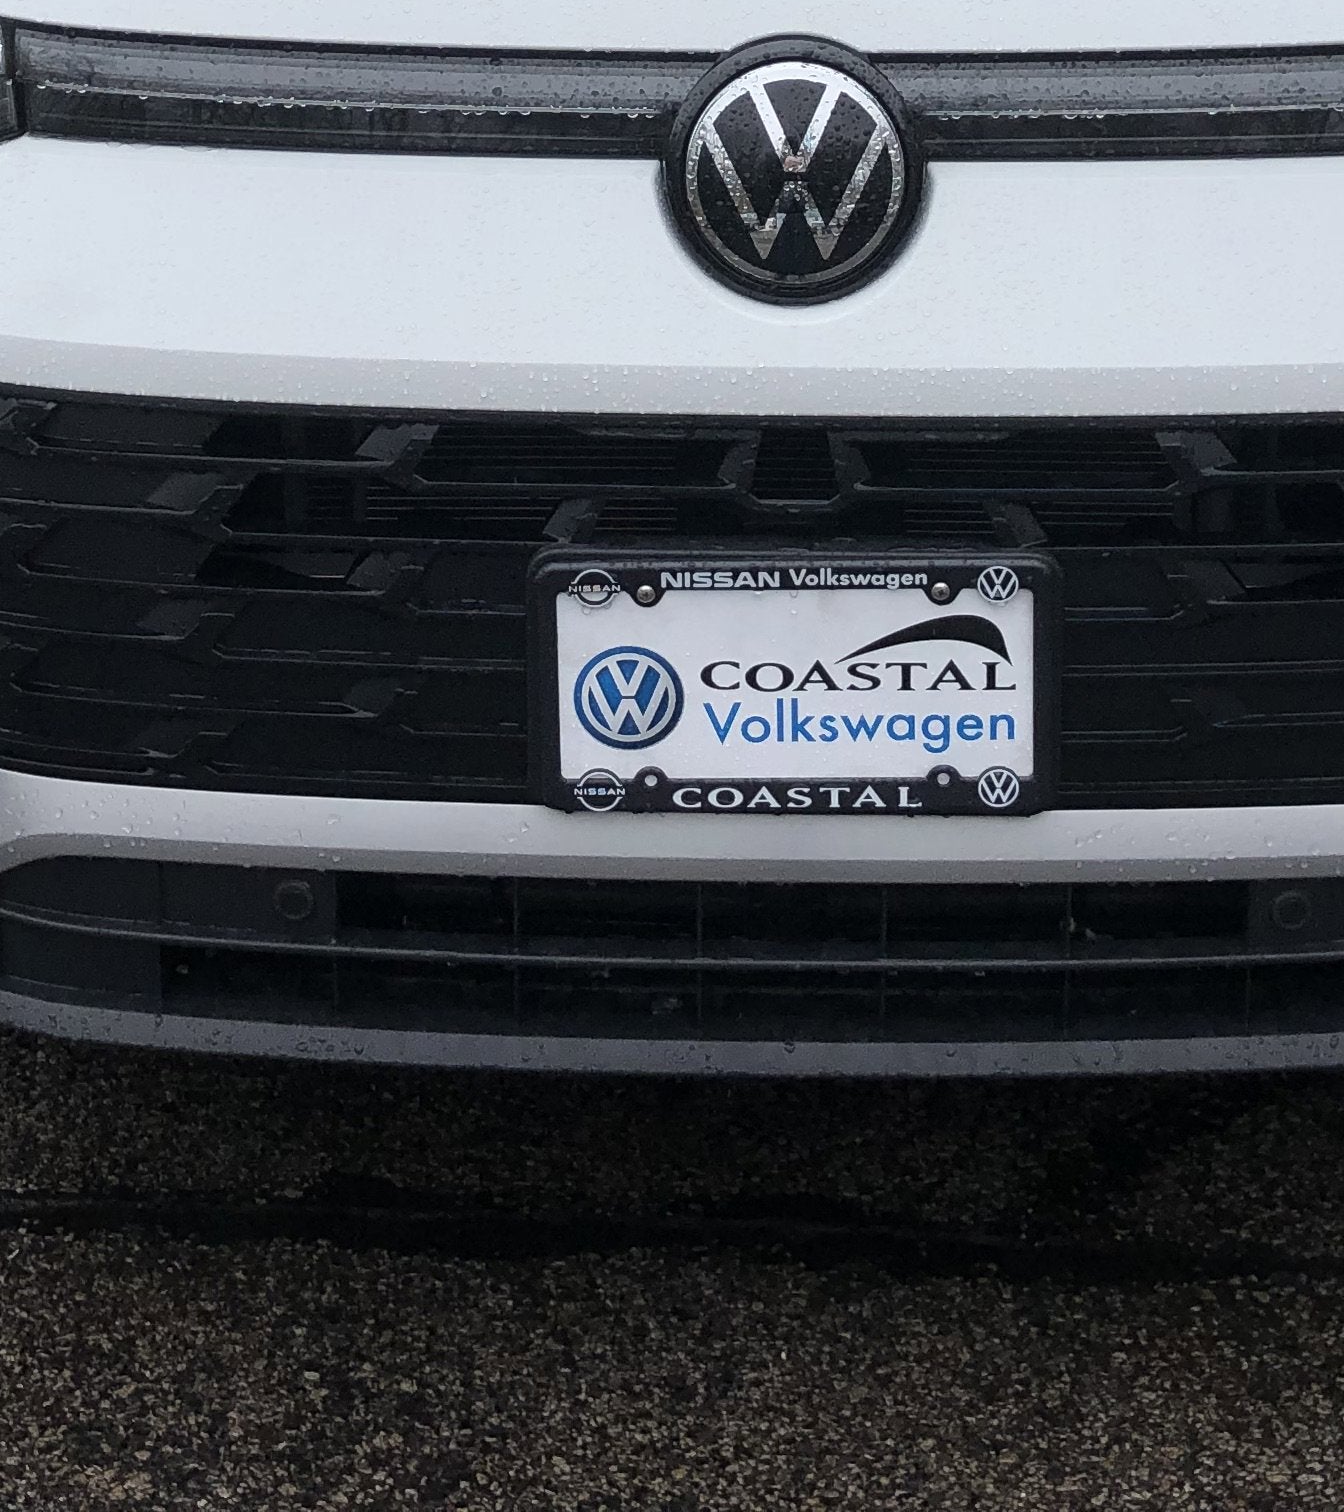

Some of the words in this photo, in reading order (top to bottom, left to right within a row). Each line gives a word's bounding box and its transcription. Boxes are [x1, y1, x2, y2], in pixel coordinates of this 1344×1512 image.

[686, 61, 905, 283] VW
[568, 584, 621, 593] NISSAN
[660, 571, 781, 589] NISSAN
[788, 567, 929, 589] Volkswagen
[977, 565, 1020, 603] VW
[699, 658, 1017, 692] COASTAL
[580, 652, 678, 743] VW
[702, 697, 1016, 754] Volkswagen
[573, 787, 626, 796] NISSAN
[671, 785, 923, 808] COASTAL
[977, 768, 1020, 808] VW
